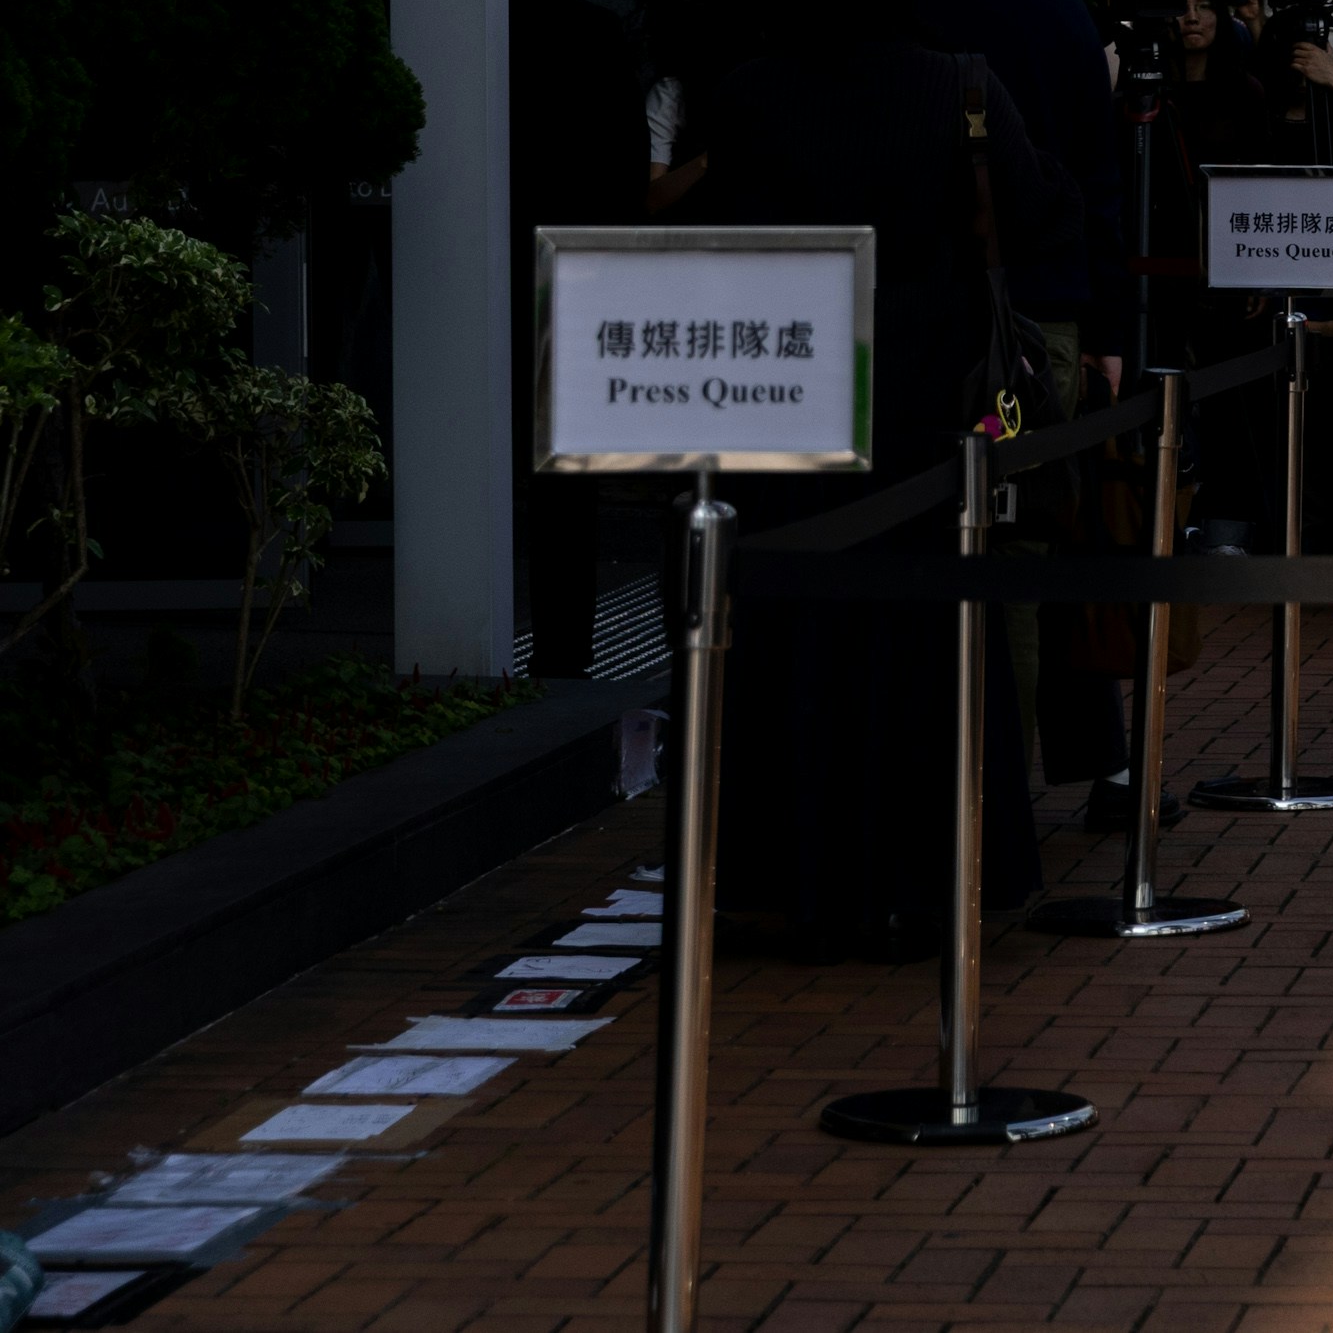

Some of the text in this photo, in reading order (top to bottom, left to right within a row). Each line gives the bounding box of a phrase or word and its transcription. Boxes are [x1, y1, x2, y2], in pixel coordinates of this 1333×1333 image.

[1235, 243, 1280, 258] Press
[597, 320, 815, 360] 傳媒排隊處
[607, 377, 804, 408] Press Queue
